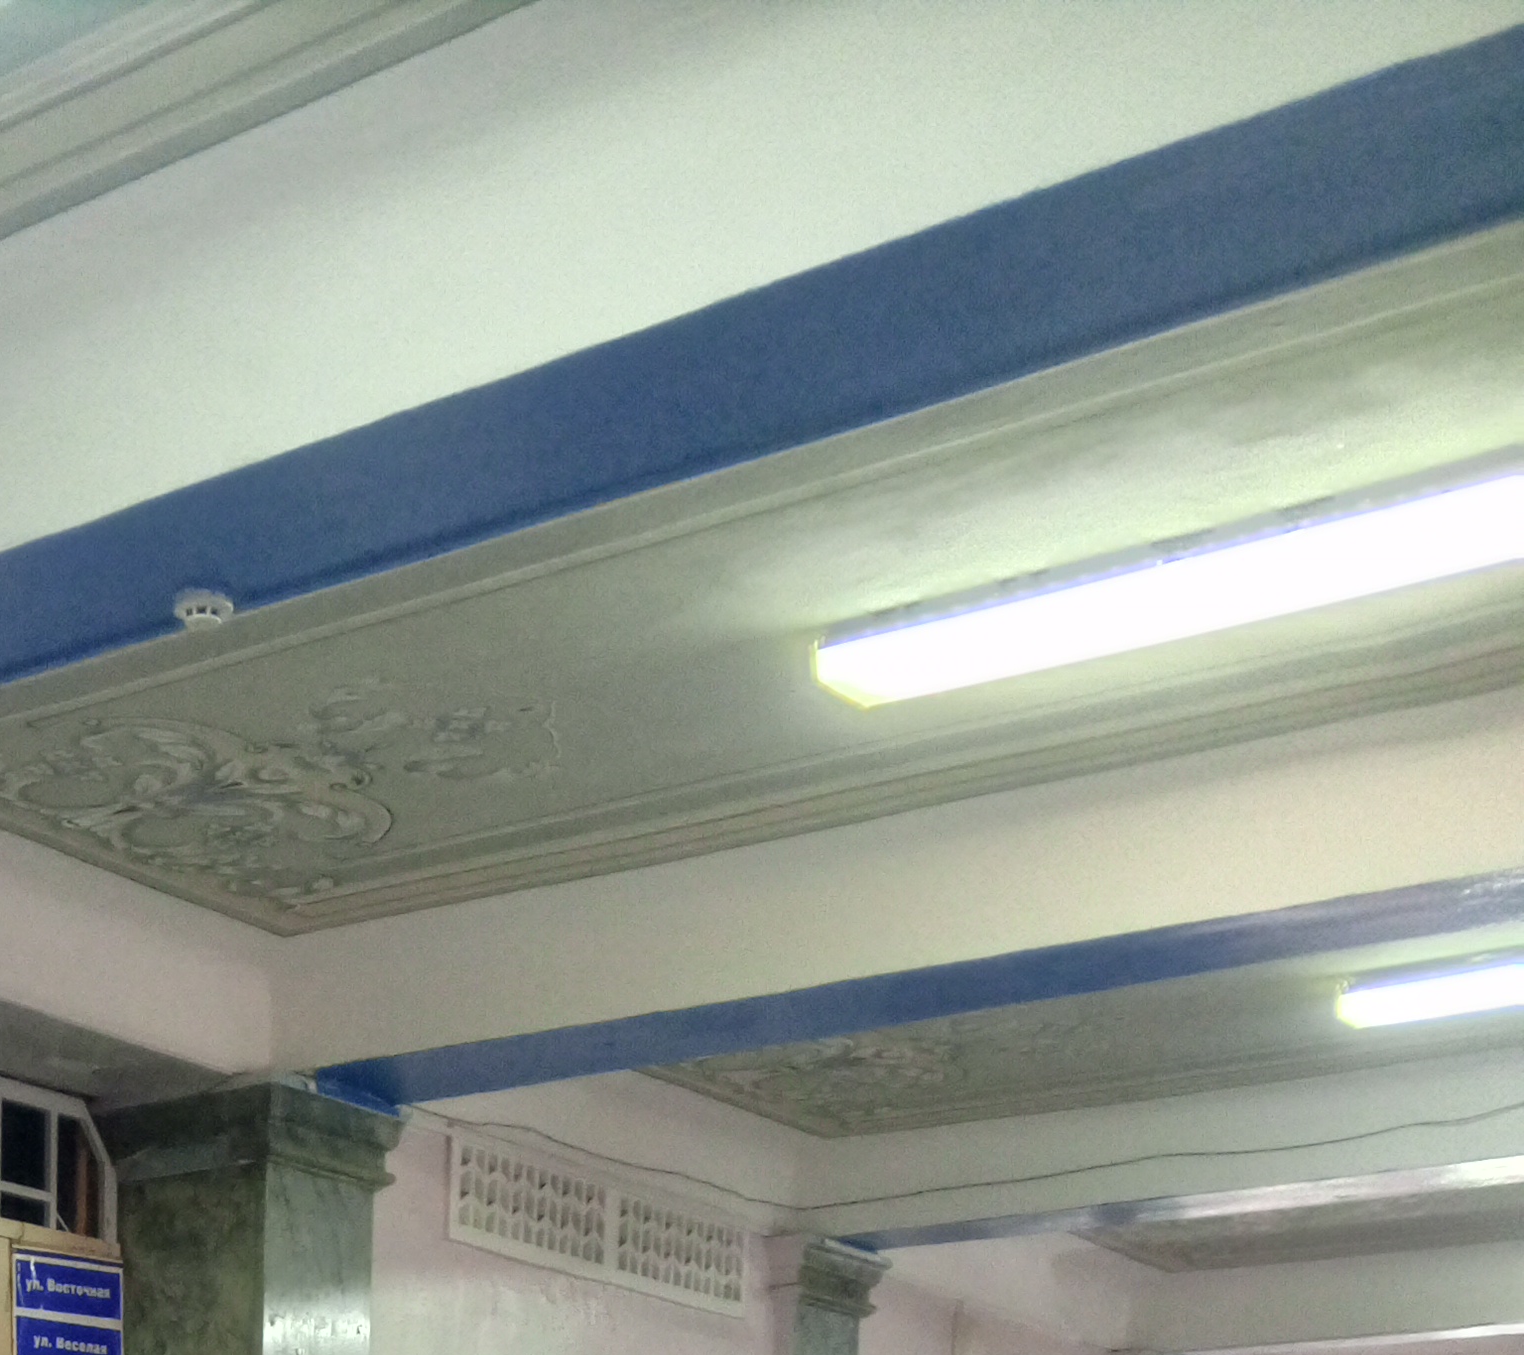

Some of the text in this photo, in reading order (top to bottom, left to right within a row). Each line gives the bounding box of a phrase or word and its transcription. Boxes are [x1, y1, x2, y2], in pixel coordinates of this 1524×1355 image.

[47, 1279, 110, 1298] Восточная
[34, 1334, 107, 1355] ул. Веселая
